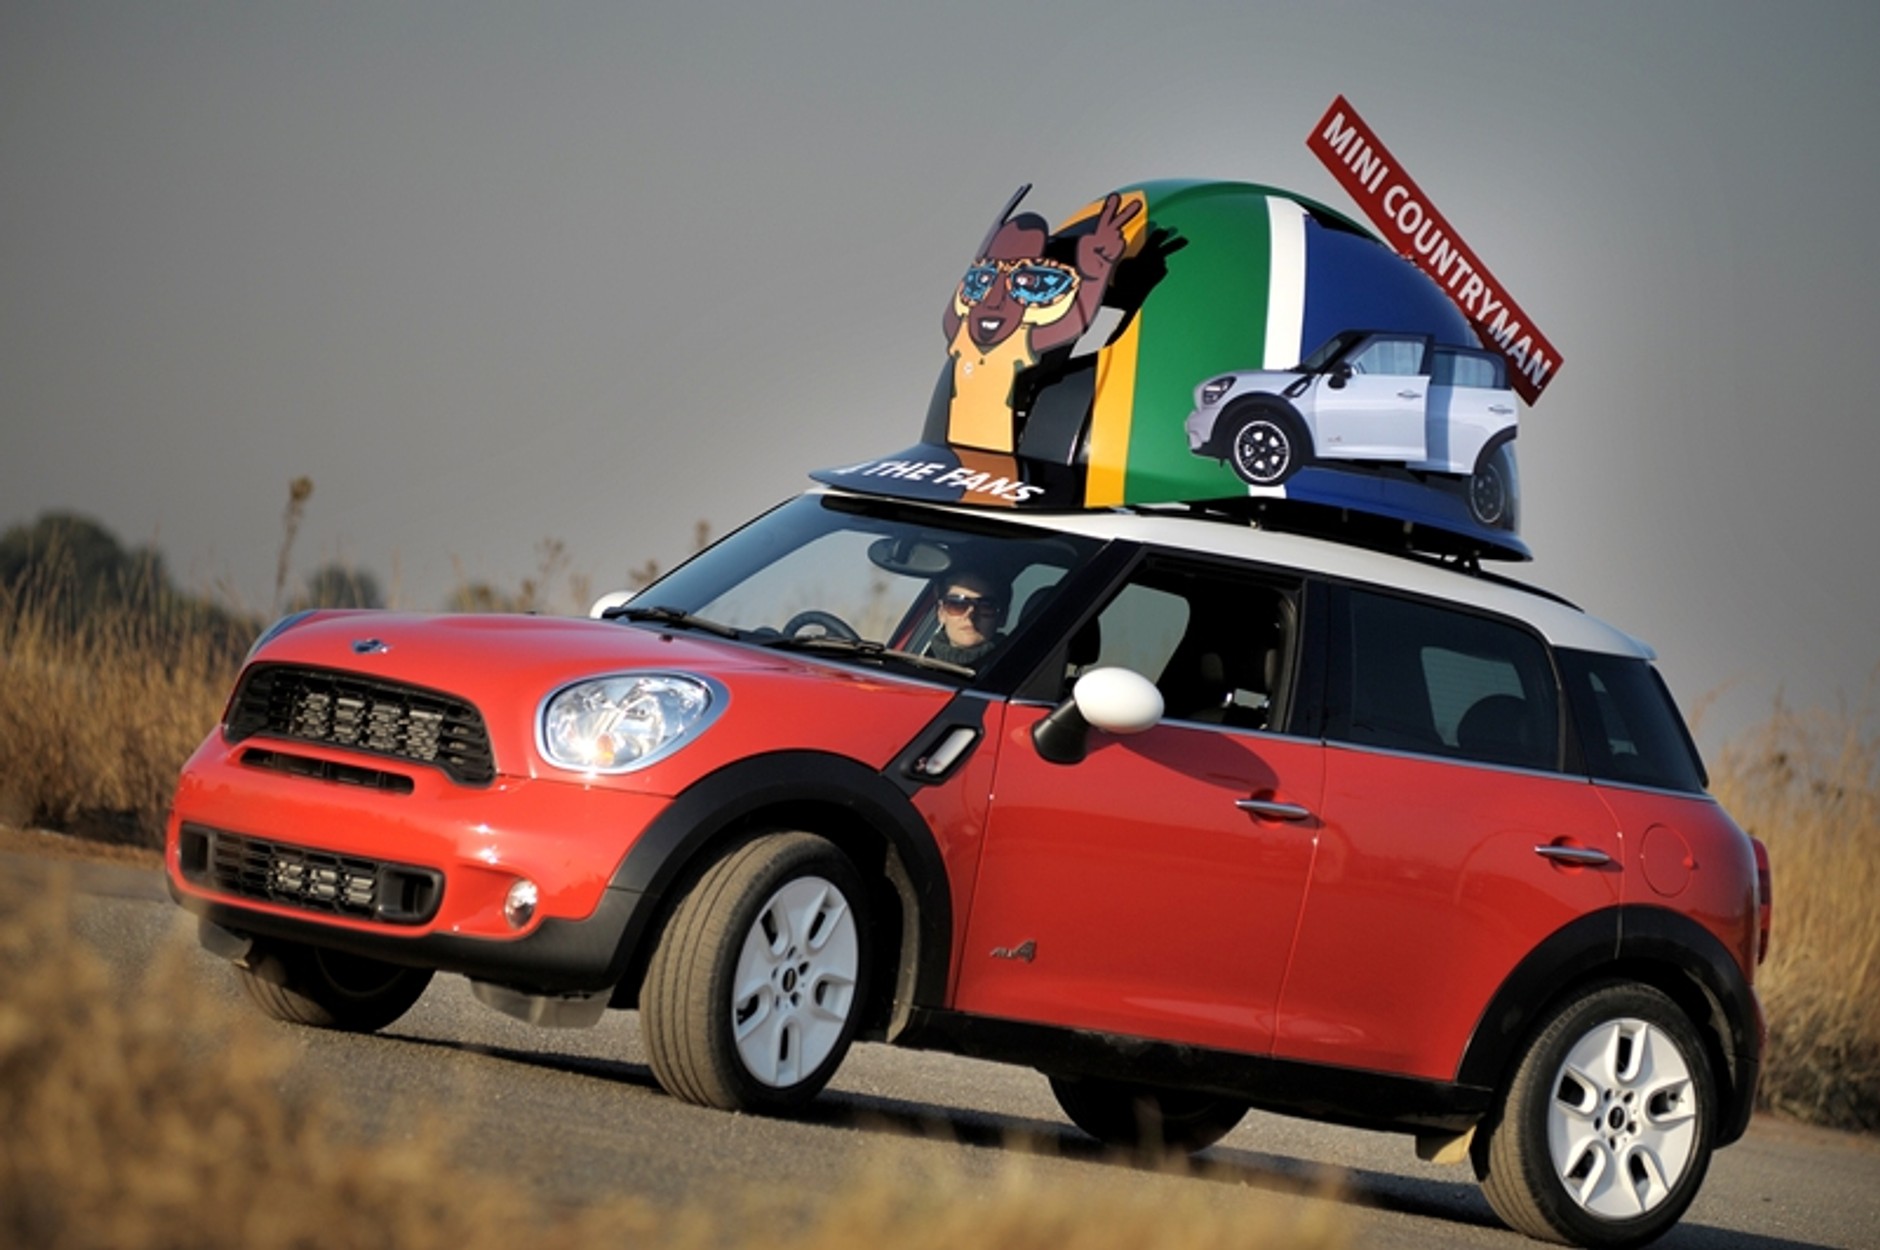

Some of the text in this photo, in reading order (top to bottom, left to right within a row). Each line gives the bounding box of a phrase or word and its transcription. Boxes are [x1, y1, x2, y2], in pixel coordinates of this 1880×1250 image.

[1322, 112, 1552, 387] MINI COUNTRYMAN
[862, 461, 945, 480] THE
[933, 466, 1045, 501] FANS
